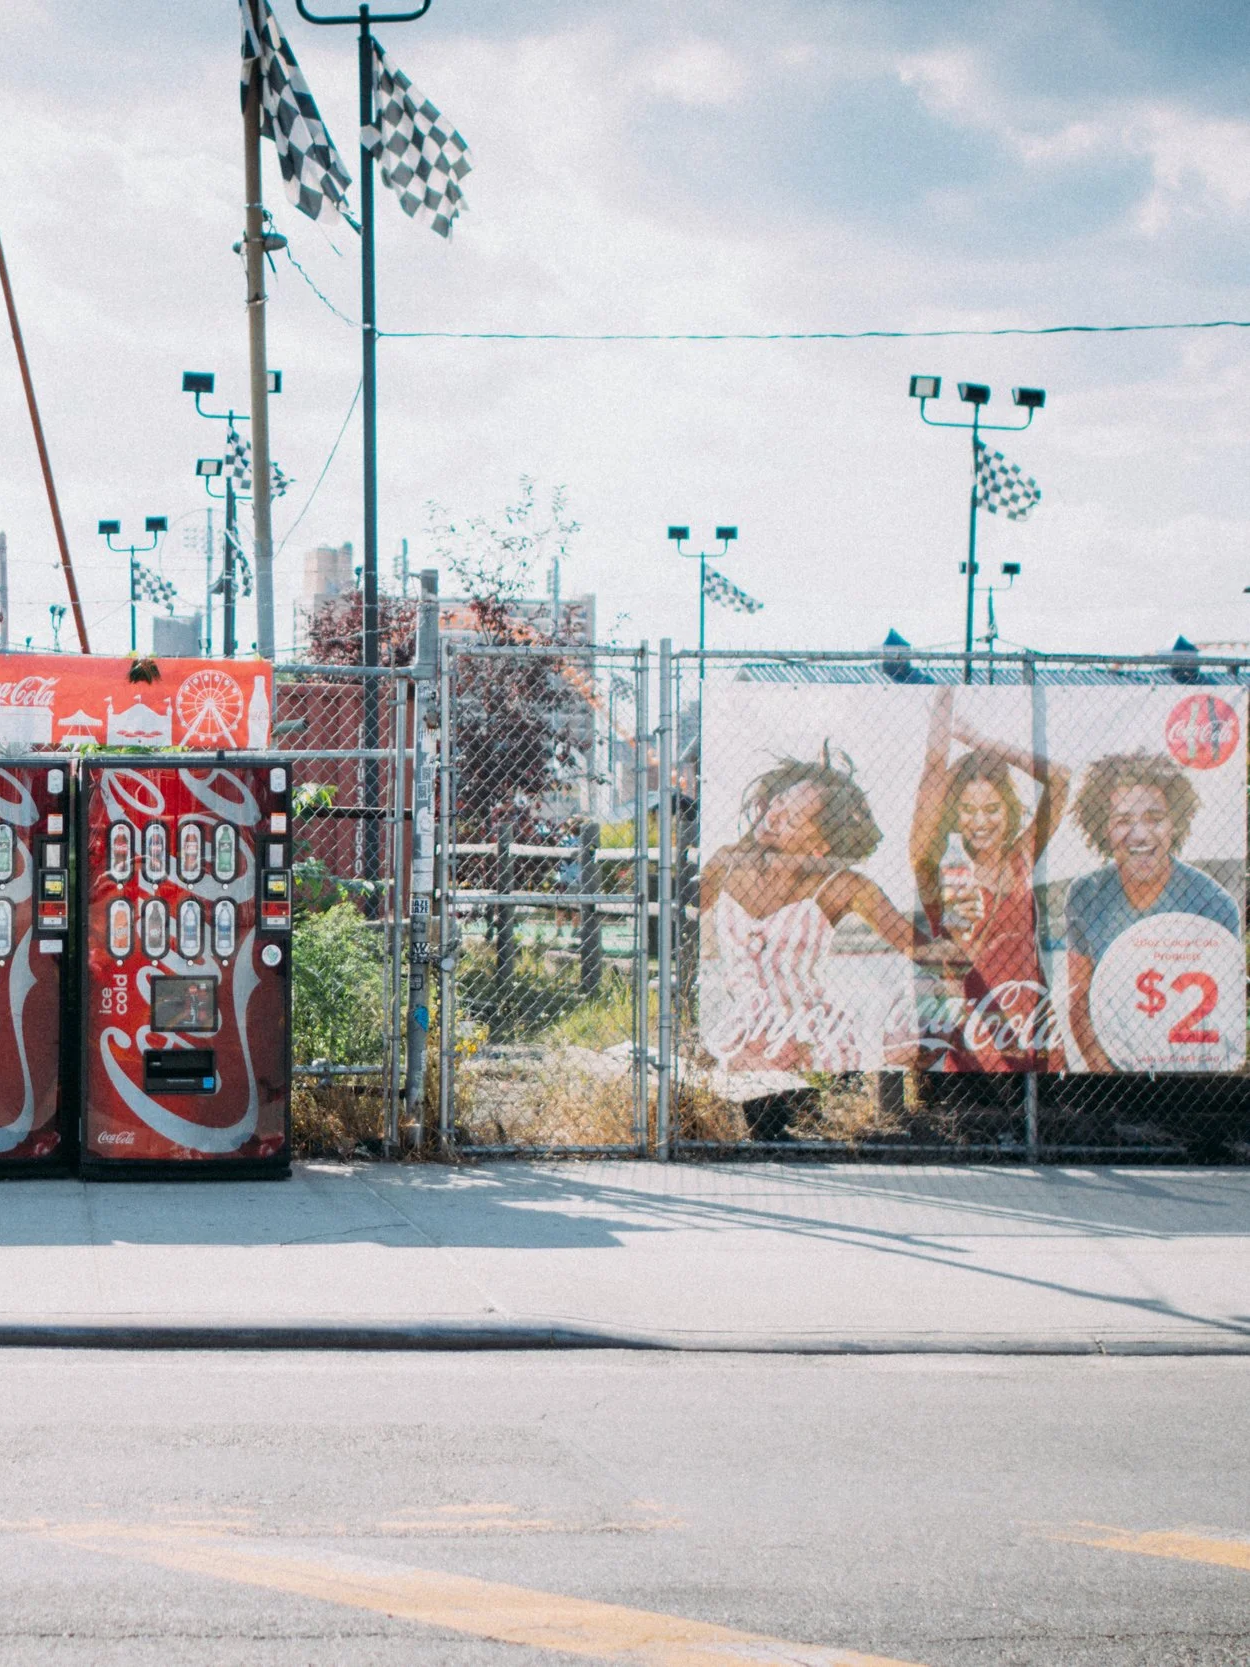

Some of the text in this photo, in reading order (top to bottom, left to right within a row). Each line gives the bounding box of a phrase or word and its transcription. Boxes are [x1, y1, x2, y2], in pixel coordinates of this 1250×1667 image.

[99, 987, 113, 1014] ice
[112, 973, 128, 1015] cold
[1135, 968, 1220, 1044] $2
